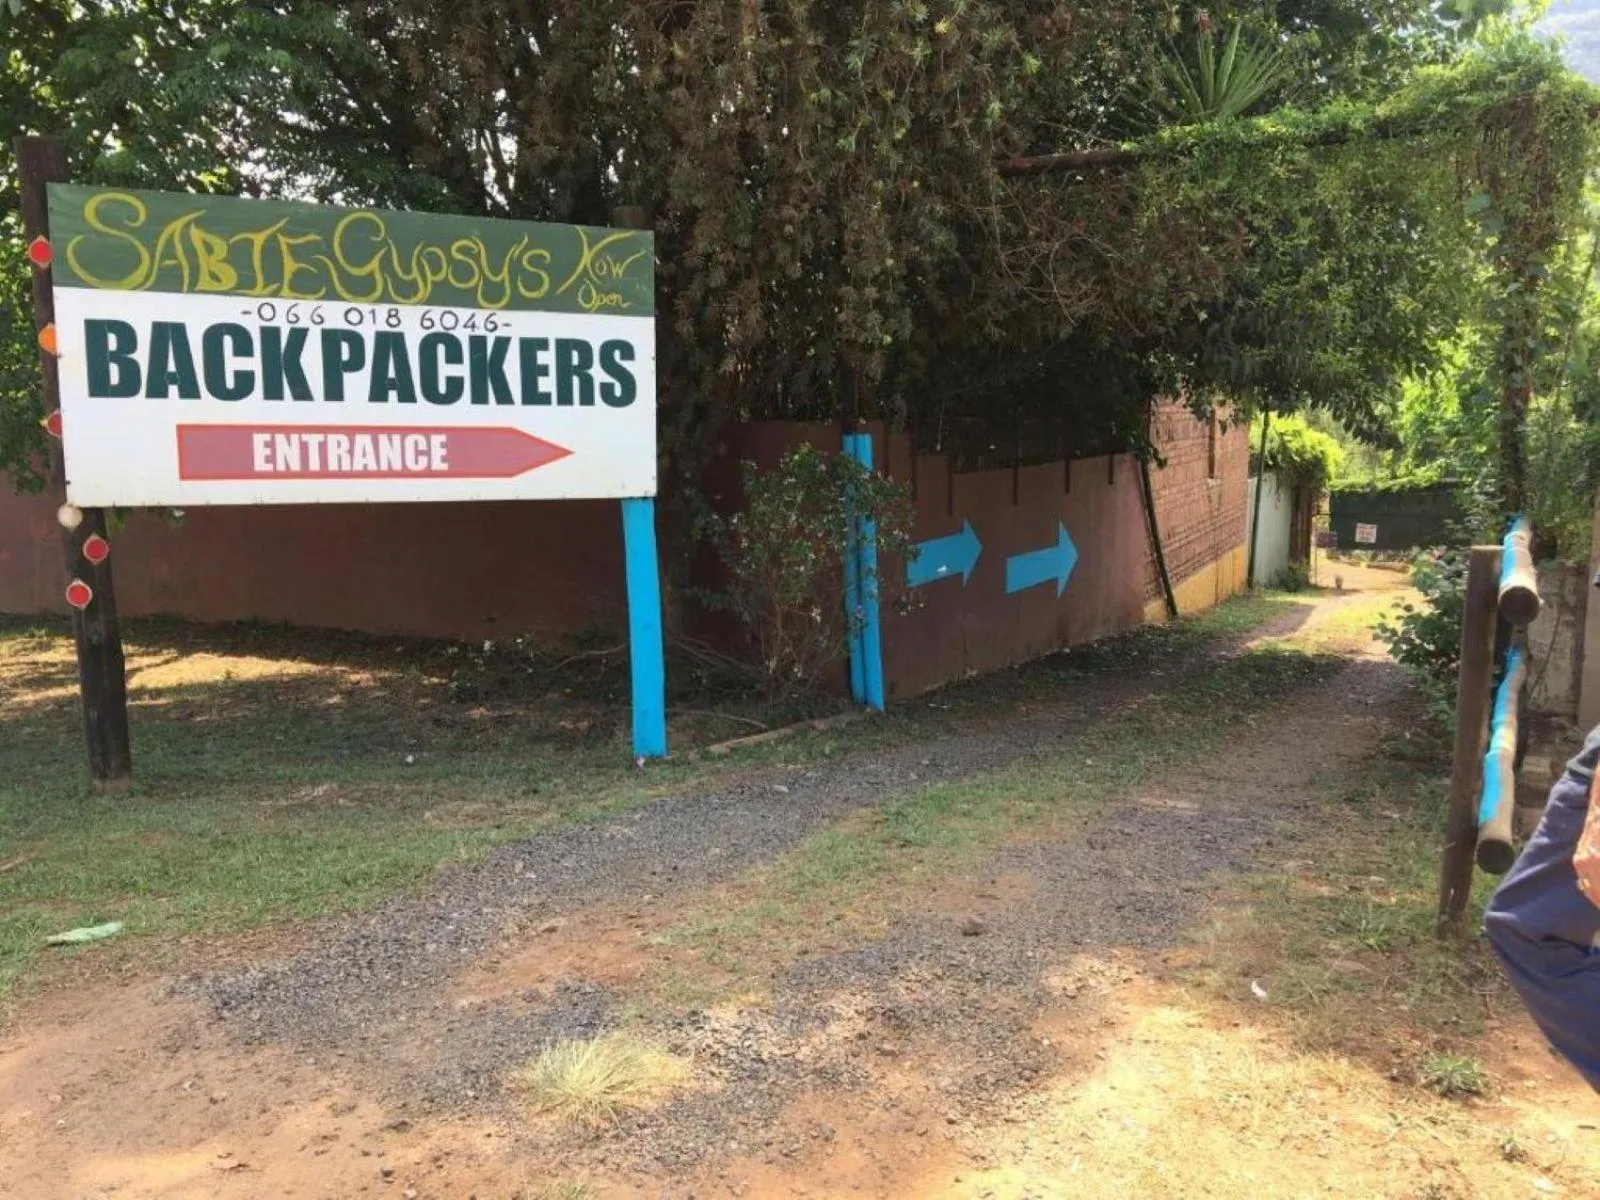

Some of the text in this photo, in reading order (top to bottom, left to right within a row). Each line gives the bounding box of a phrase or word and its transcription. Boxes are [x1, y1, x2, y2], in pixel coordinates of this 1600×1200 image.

[67, 191, 326, 300] SABIE
[578, 278, 631, 312] Open
[344, 306, 402, 327] 018
[84, 318, 637, 408] BACKPACKERS
[252, 432, 448, 472] ENTRANCE
